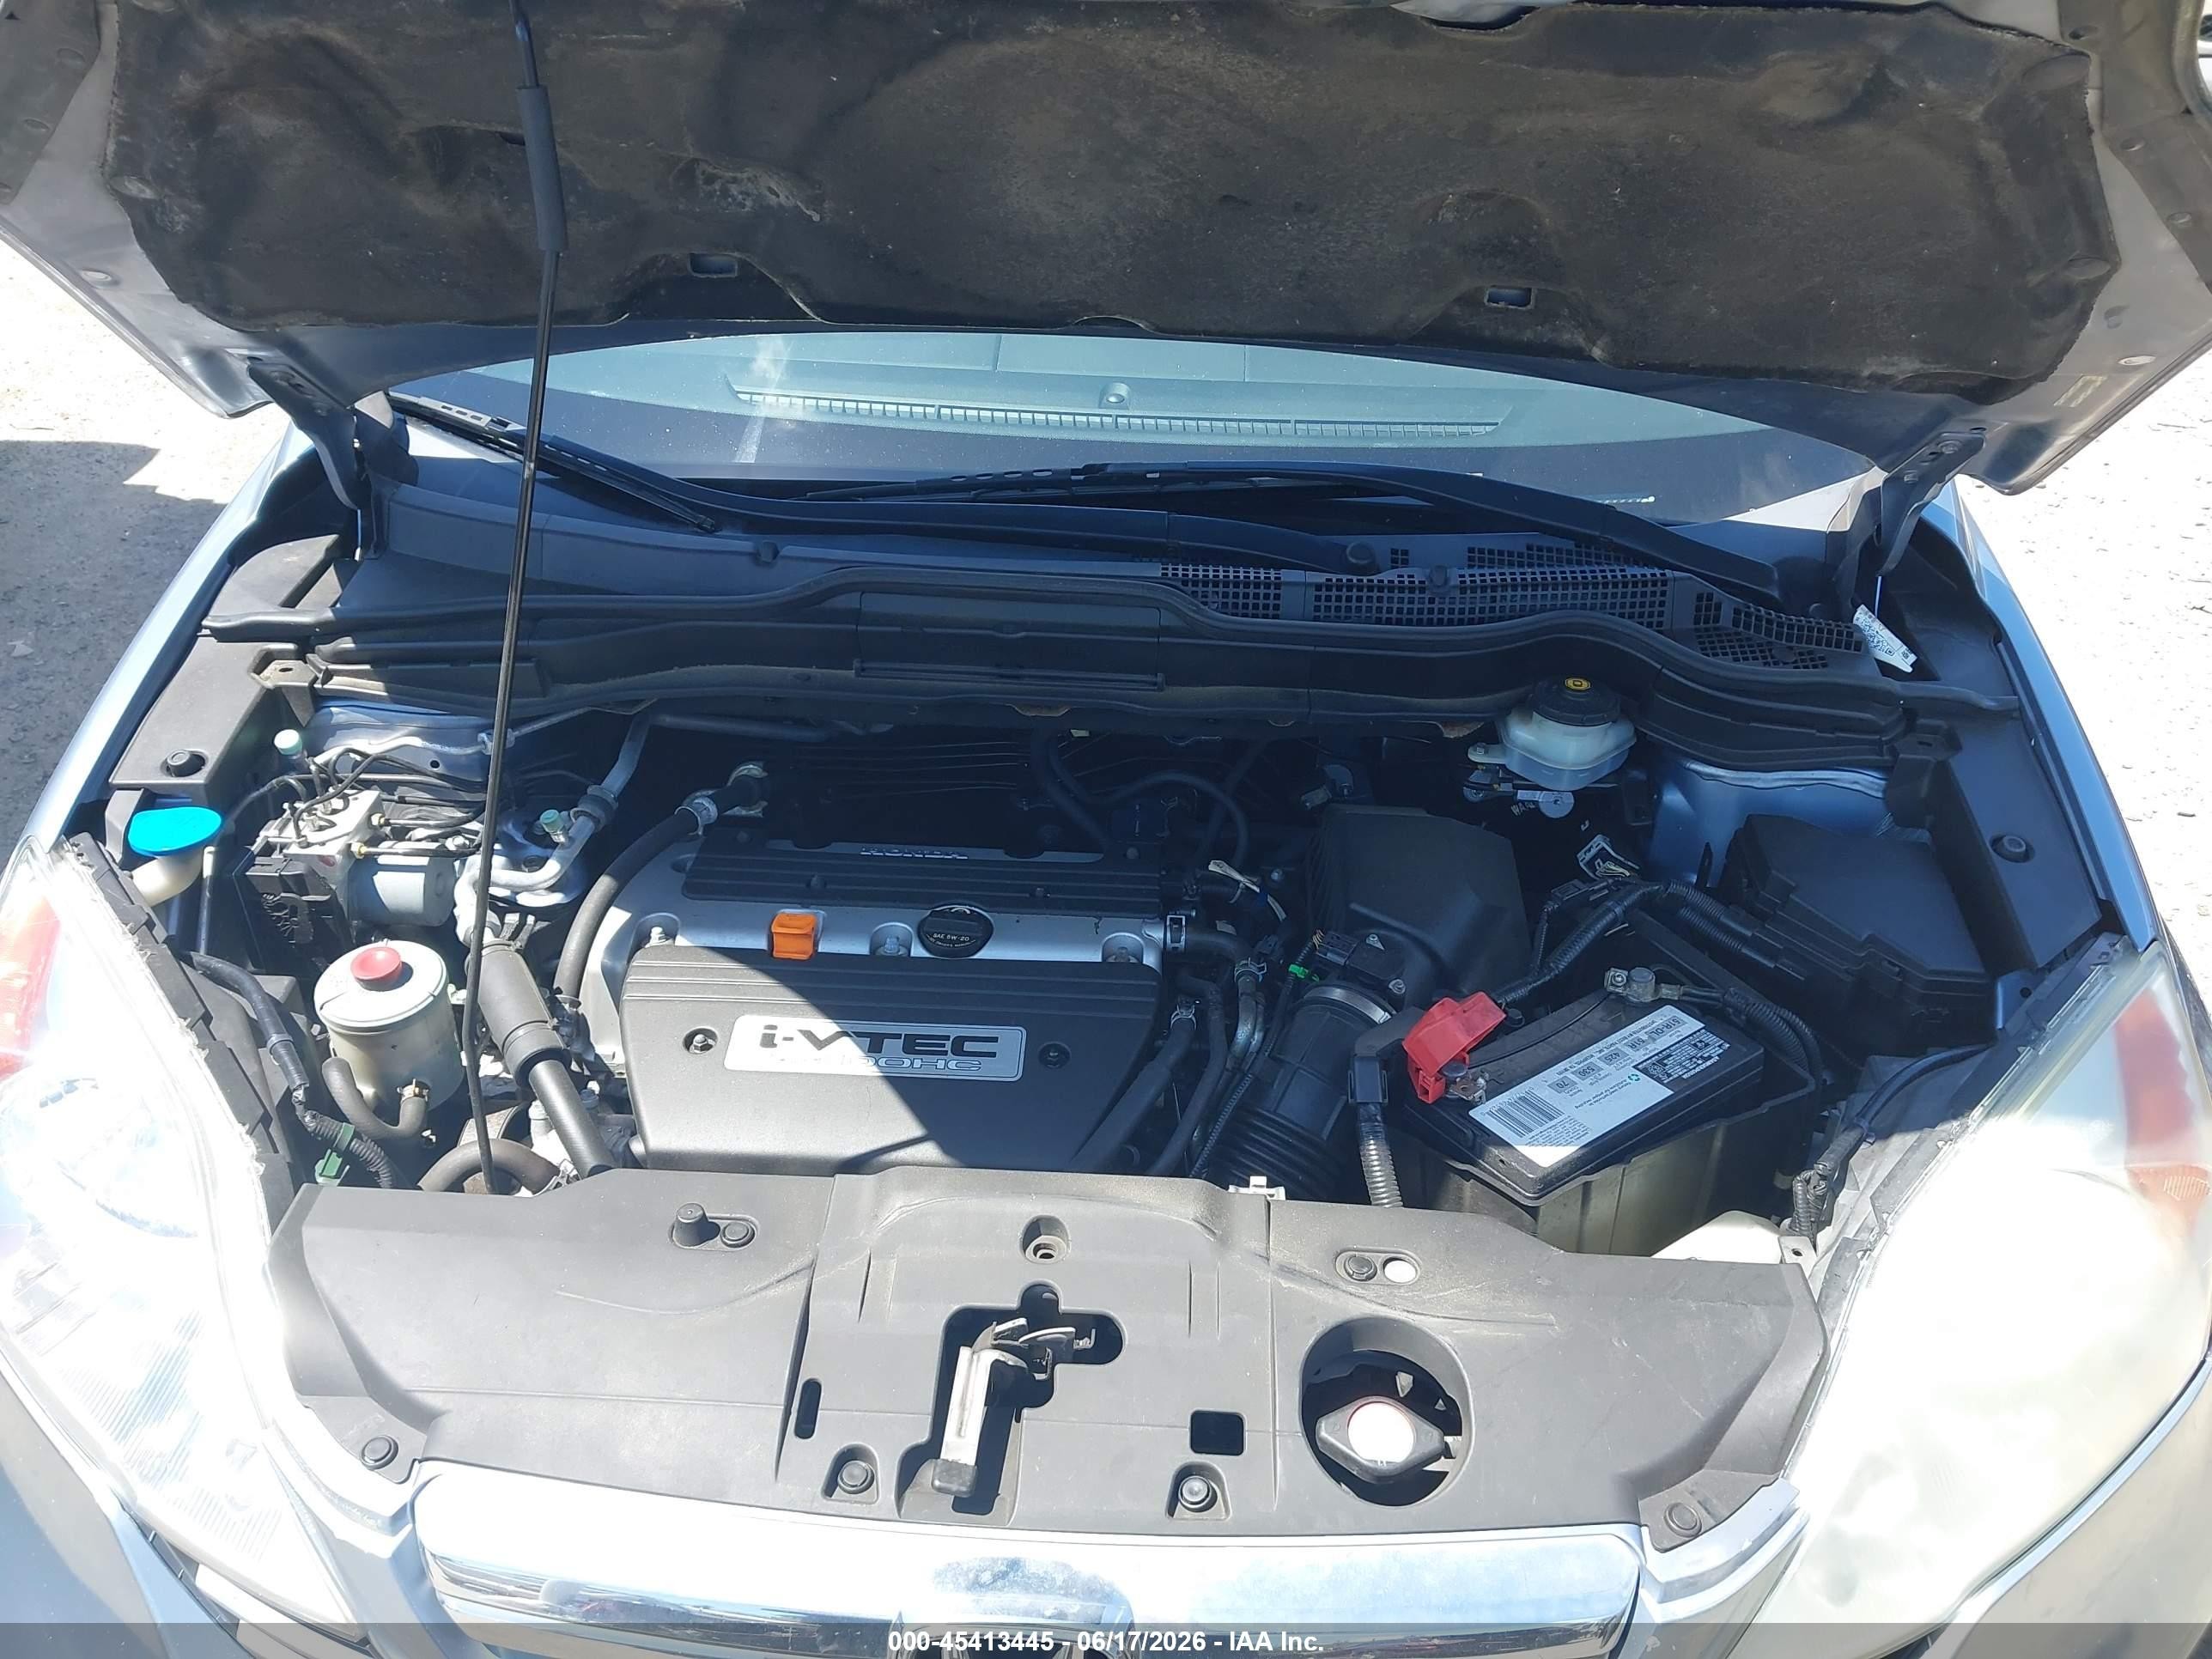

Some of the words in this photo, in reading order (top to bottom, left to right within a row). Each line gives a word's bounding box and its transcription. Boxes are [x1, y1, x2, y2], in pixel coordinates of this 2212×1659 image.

[759, 1024, 1000, 1060] i-VTEC
[1626, 1037, 1646, 1048] 51R
[1603, 1051, 1622, 1062] 425
[1577, 1066, 1595, 1077] 530
[1554, 1079, 1570, 1089] 70
